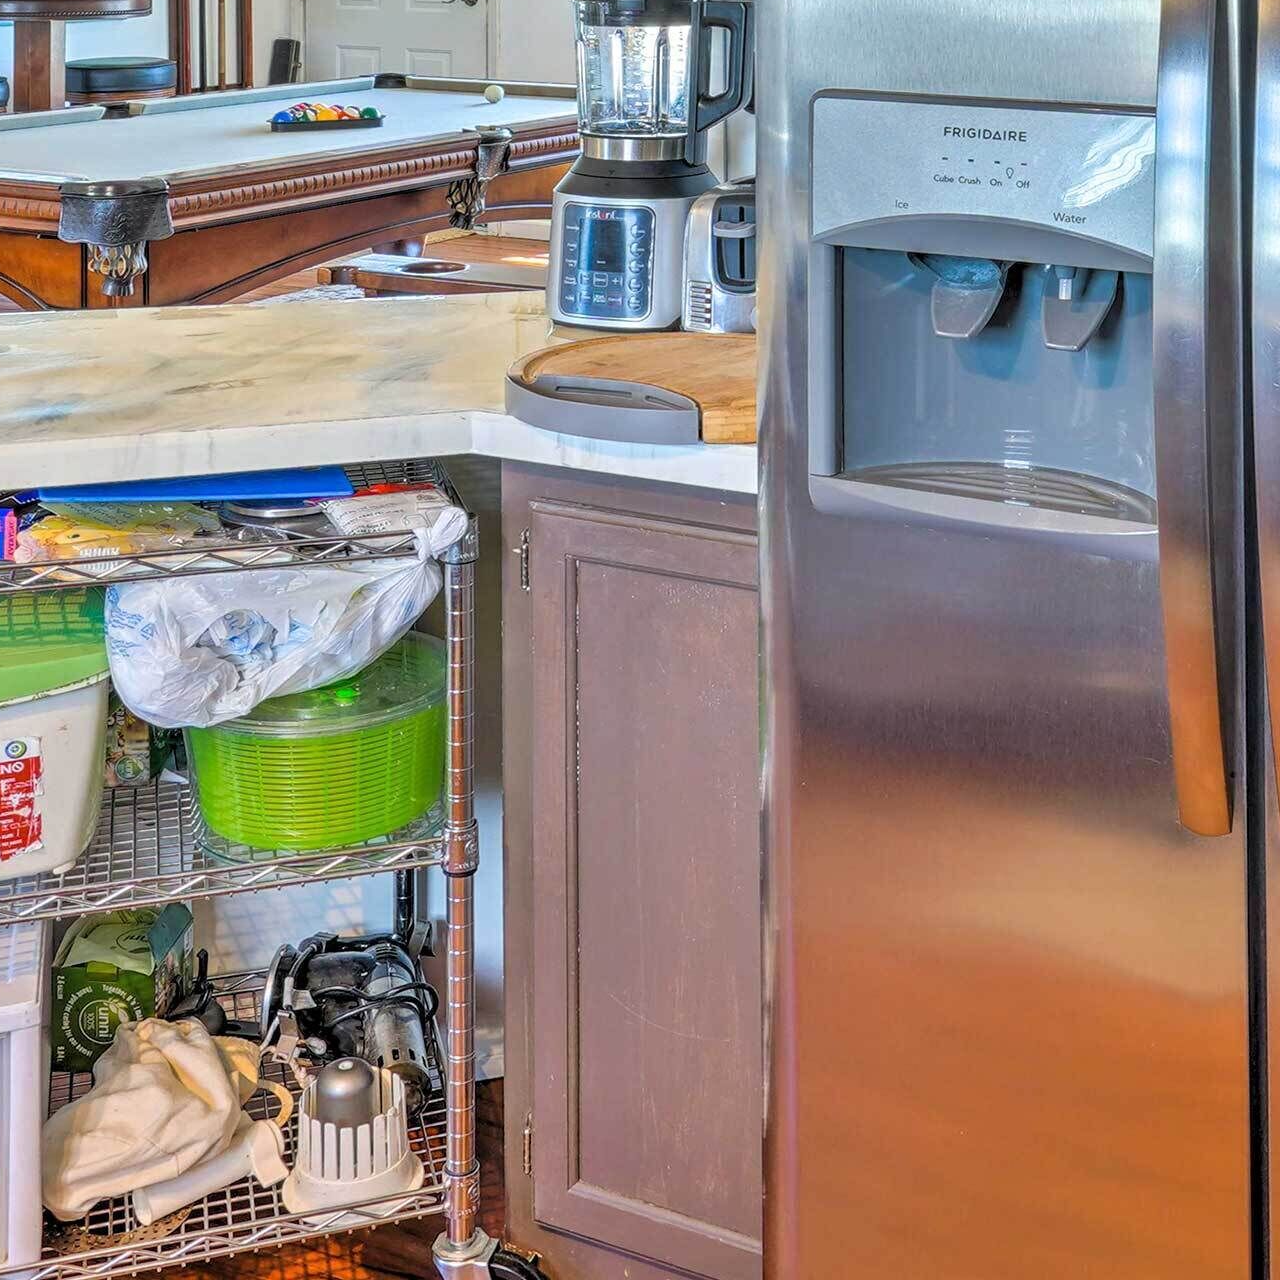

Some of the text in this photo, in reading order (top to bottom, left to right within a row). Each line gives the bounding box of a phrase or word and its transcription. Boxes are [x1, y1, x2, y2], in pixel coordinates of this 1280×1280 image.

[943, 126, 1028, 143] FRIGIDAIRE
[933, 173, 955, 183] Cube
[958, 175, 982, 185] Crush
[989, 178, 1003, 187] On
[1015, 179, 1031, 189] Off
[894, 199, 909, 210] Ice
[1053, 211, 1087, 226] Water
[0, 761, 24, 774] NO
[98, 1006, 113, 1038] unni
